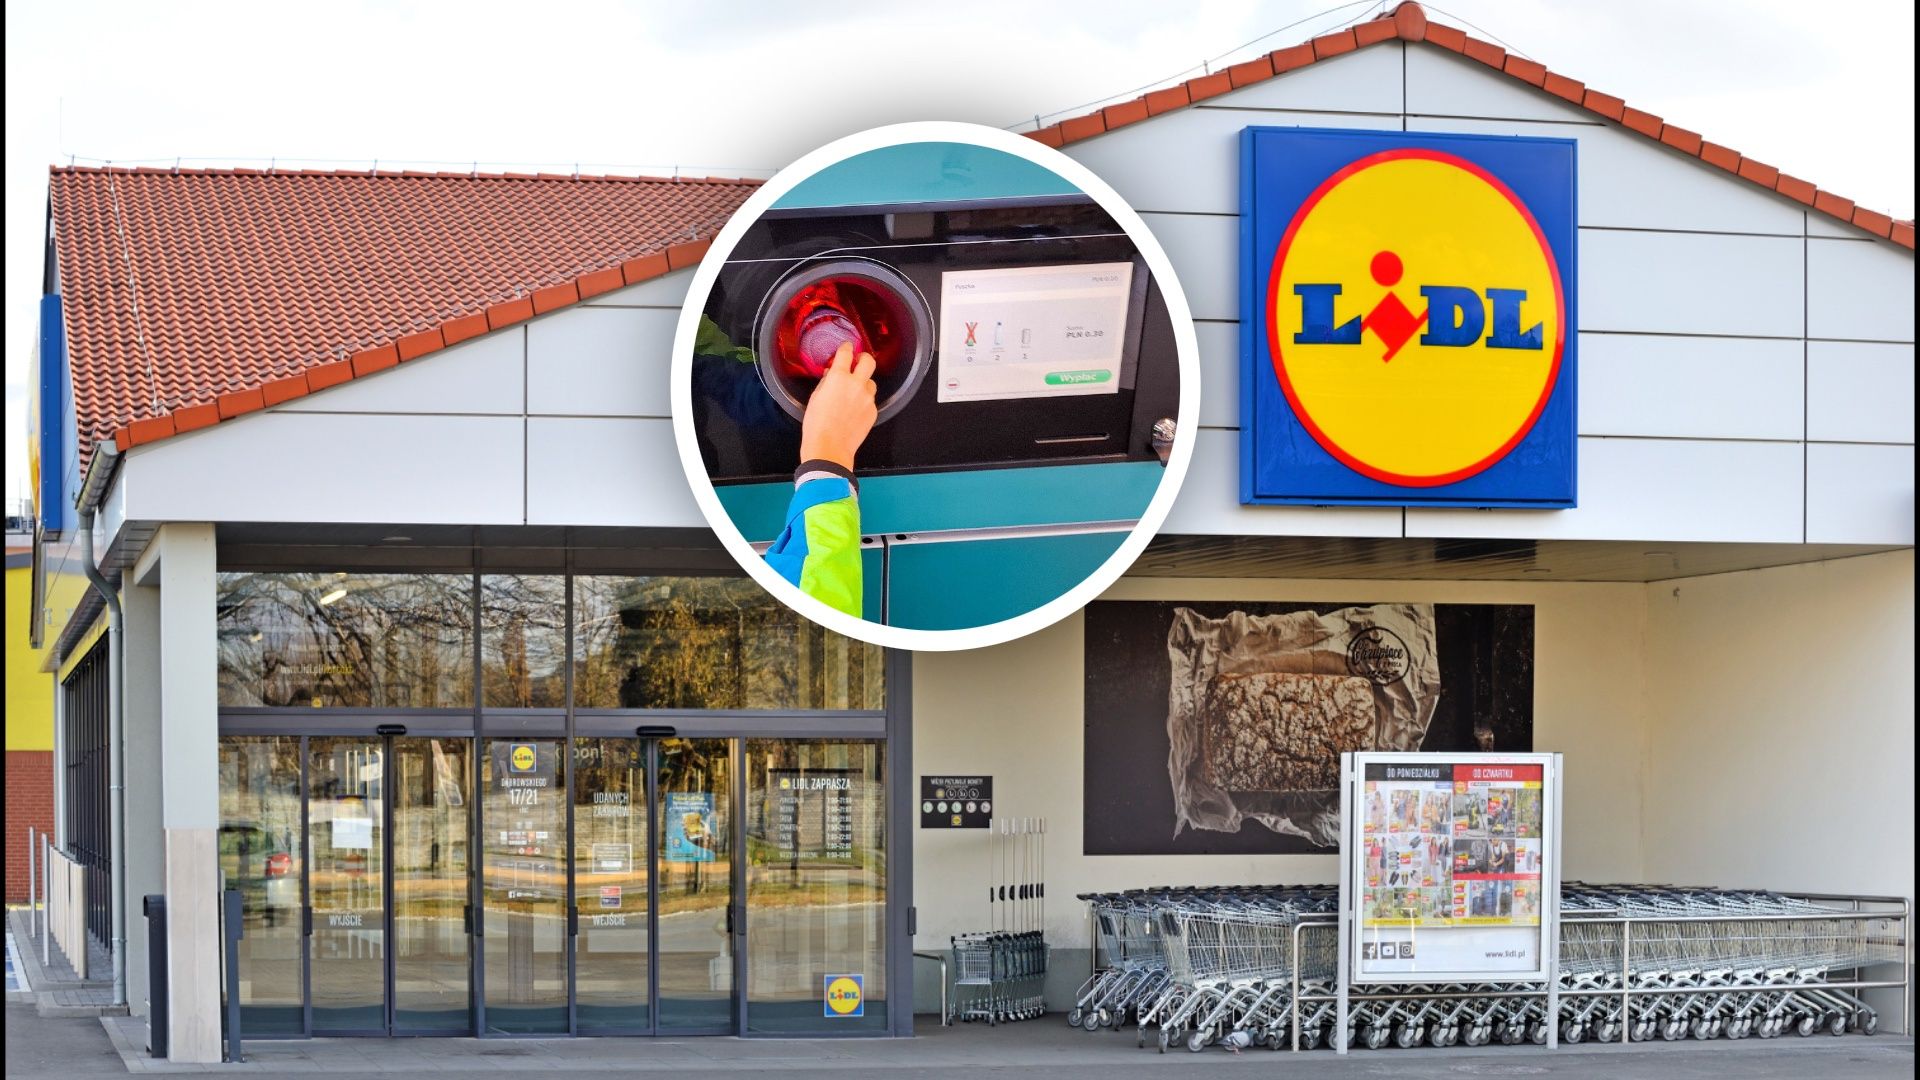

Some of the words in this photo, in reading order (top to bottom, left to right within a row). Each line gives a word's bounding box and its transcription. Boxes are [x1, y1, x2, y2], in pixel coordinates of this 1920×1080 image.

[793, 778, 809, 790] LIDL
[811, 778, 851, 790] ZAPRASZA
[510, 788, 538, 805] 17/21
[593, 791, 629, 804] UDANYCH
[328, 913, 363, 927] WYJŚCIE
[592, 912, 626, 927] WEJŚCIE
[1485, 950, 1526, 959] www.lidl.pl
